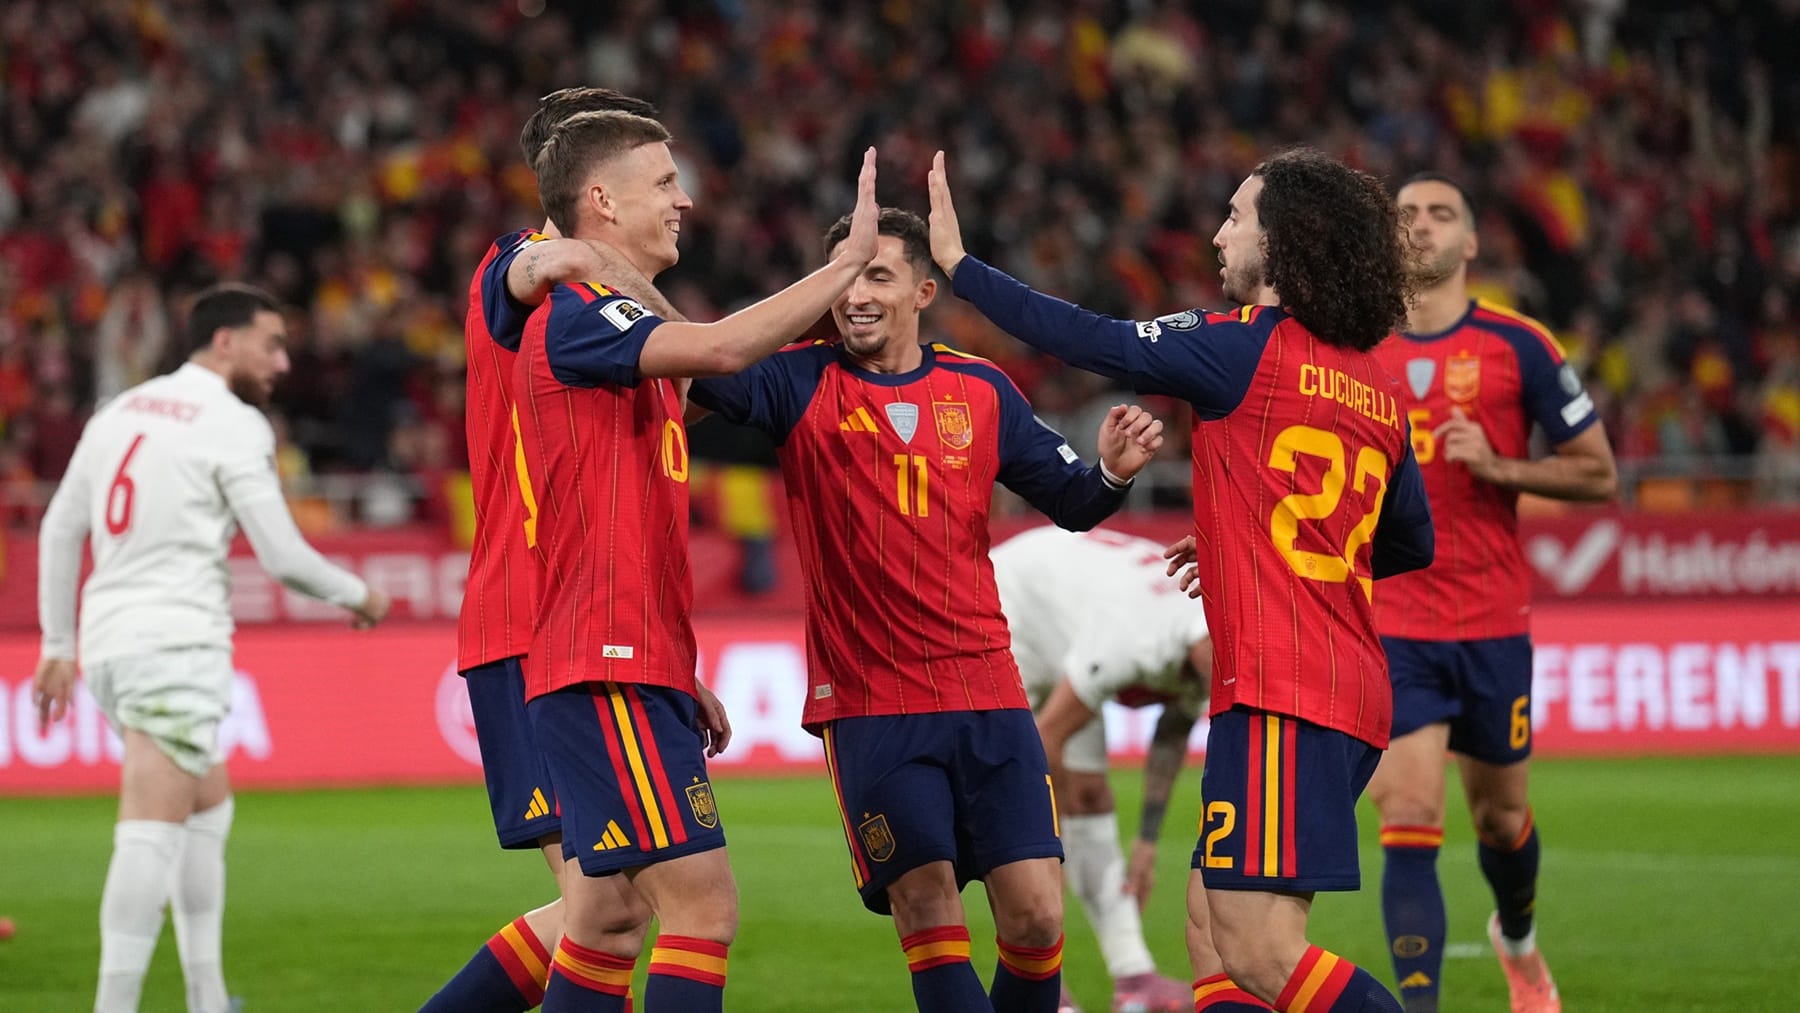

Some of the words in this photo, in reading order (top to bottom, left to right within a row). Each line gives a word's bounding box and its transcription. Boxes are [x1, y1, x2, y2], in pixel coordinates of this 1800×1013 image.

[1299, 363, 1399, 430] CUCURELLA
[103, 433, 146, 538] 6
[894, 454, 930, 517] 11
[1268, 425, 1387, 606] 22
[1509, 695, 1530, 750] 6
[1199, 800, 1233, 869] 2
